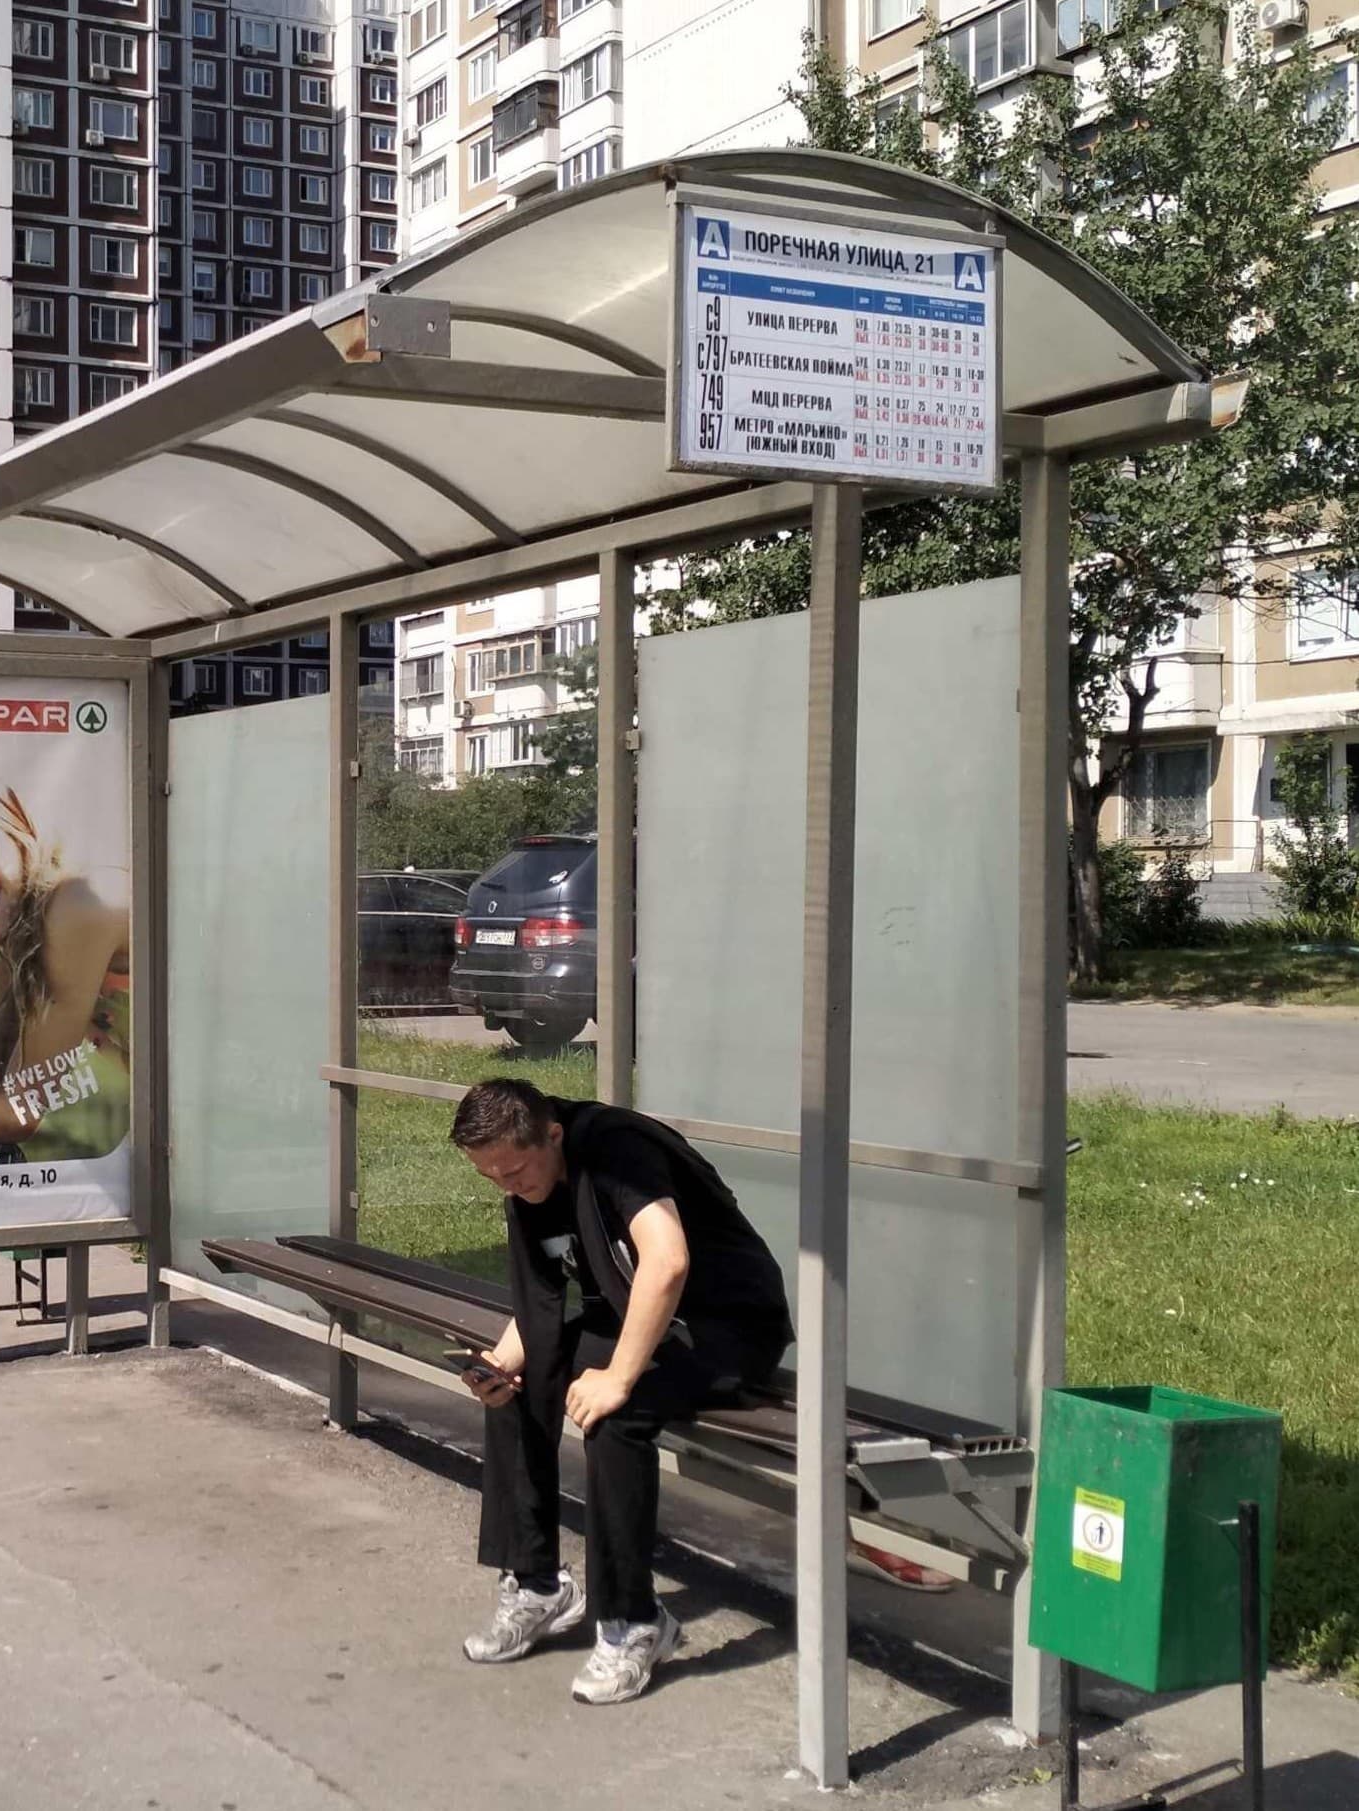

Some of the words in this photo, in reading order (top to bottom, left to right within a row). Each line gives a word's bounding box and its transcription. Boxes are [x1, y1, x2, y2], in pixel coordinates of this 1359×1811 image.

[744, 230, 840, 263] ПОРЕЧНАЯ
[845, 243, 909, 274] УЛИЦА,
[915, 255, 935, 275] 21
[747, 311, 785, 330] УЛИЦА
[788, 315, 838, 336] ПЕРЕРВА
[730, 349, 810, 373] БРАТЕЕВСКАЯ
[812, 356, 854, 377] ПОЙМА
[700, 374, 723, 411] 749
[751, 389, 780, 408] МЦД
[782, 392, 832, 412] ПЕРЕРВА
[699, 413, 723, 451] 957
[734, 416, 775, 435] МЕТРО
[777, 420, 848, 441] «МАРЬИНО»
[746, 434, 793, 456] (ЮЖНЫЙ
[795, 440, 836, 460] ВХОД)
[2, 1063, 44, 1096] #WE
[8, 1066, 99, 1126] FRESH
[19, 1173, 34, 1189] д.
[40, 1169, 57, 1184] 10
